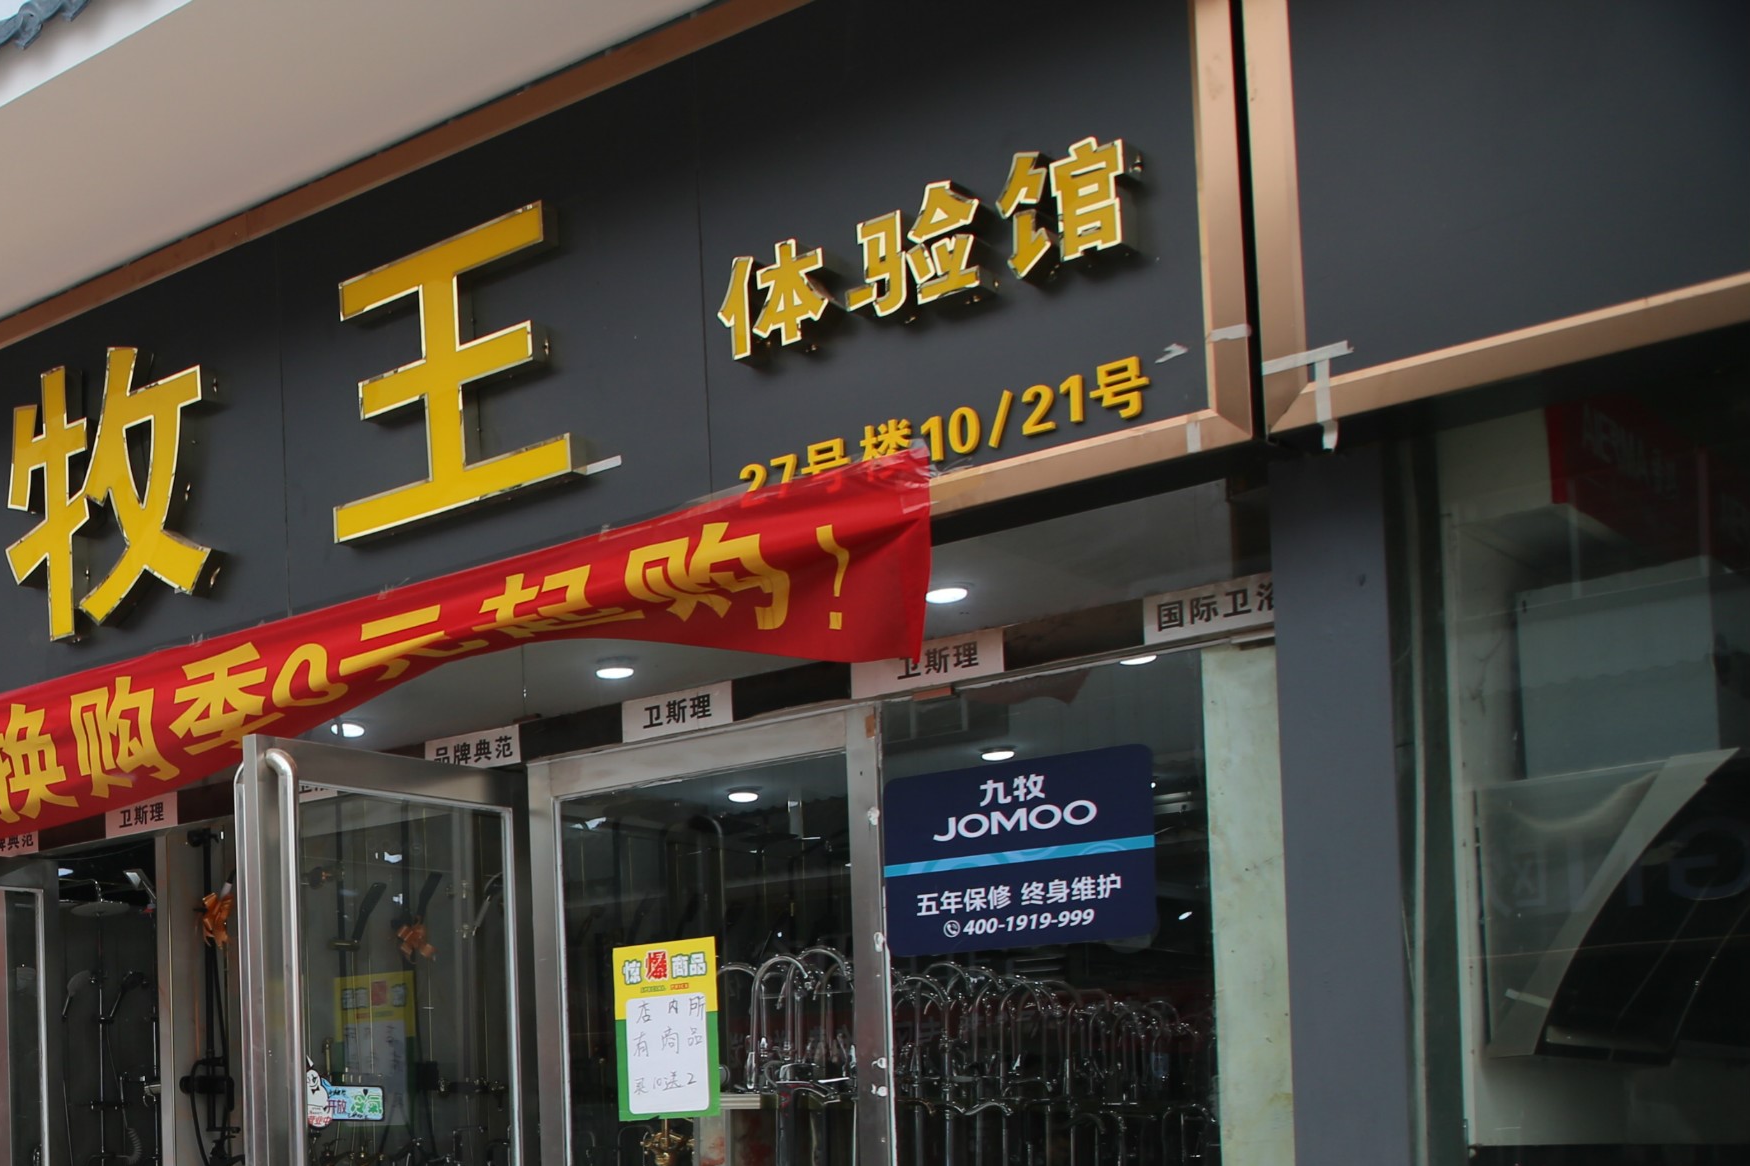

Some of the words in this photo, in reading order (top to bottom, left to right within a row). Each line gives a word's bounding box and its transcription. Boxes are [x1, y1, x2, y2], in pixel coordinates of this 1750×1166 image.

[717, 135, 1127, 361] 体验馆
[641, 692, 713, 729] 卫斯理
[979, 773, 1046, 807] 九牧
[118, 800, 165, 829] 卫斯理
[932, 799, 1098, 842] JOMOO
[916, 885, 1012, 917] 五年保修
[1020, 873, 1122, 907] 终身维护
[962, 908, 1095, 936] 400-1919-999
[622, 951, 707, 985] 惊爆商品
